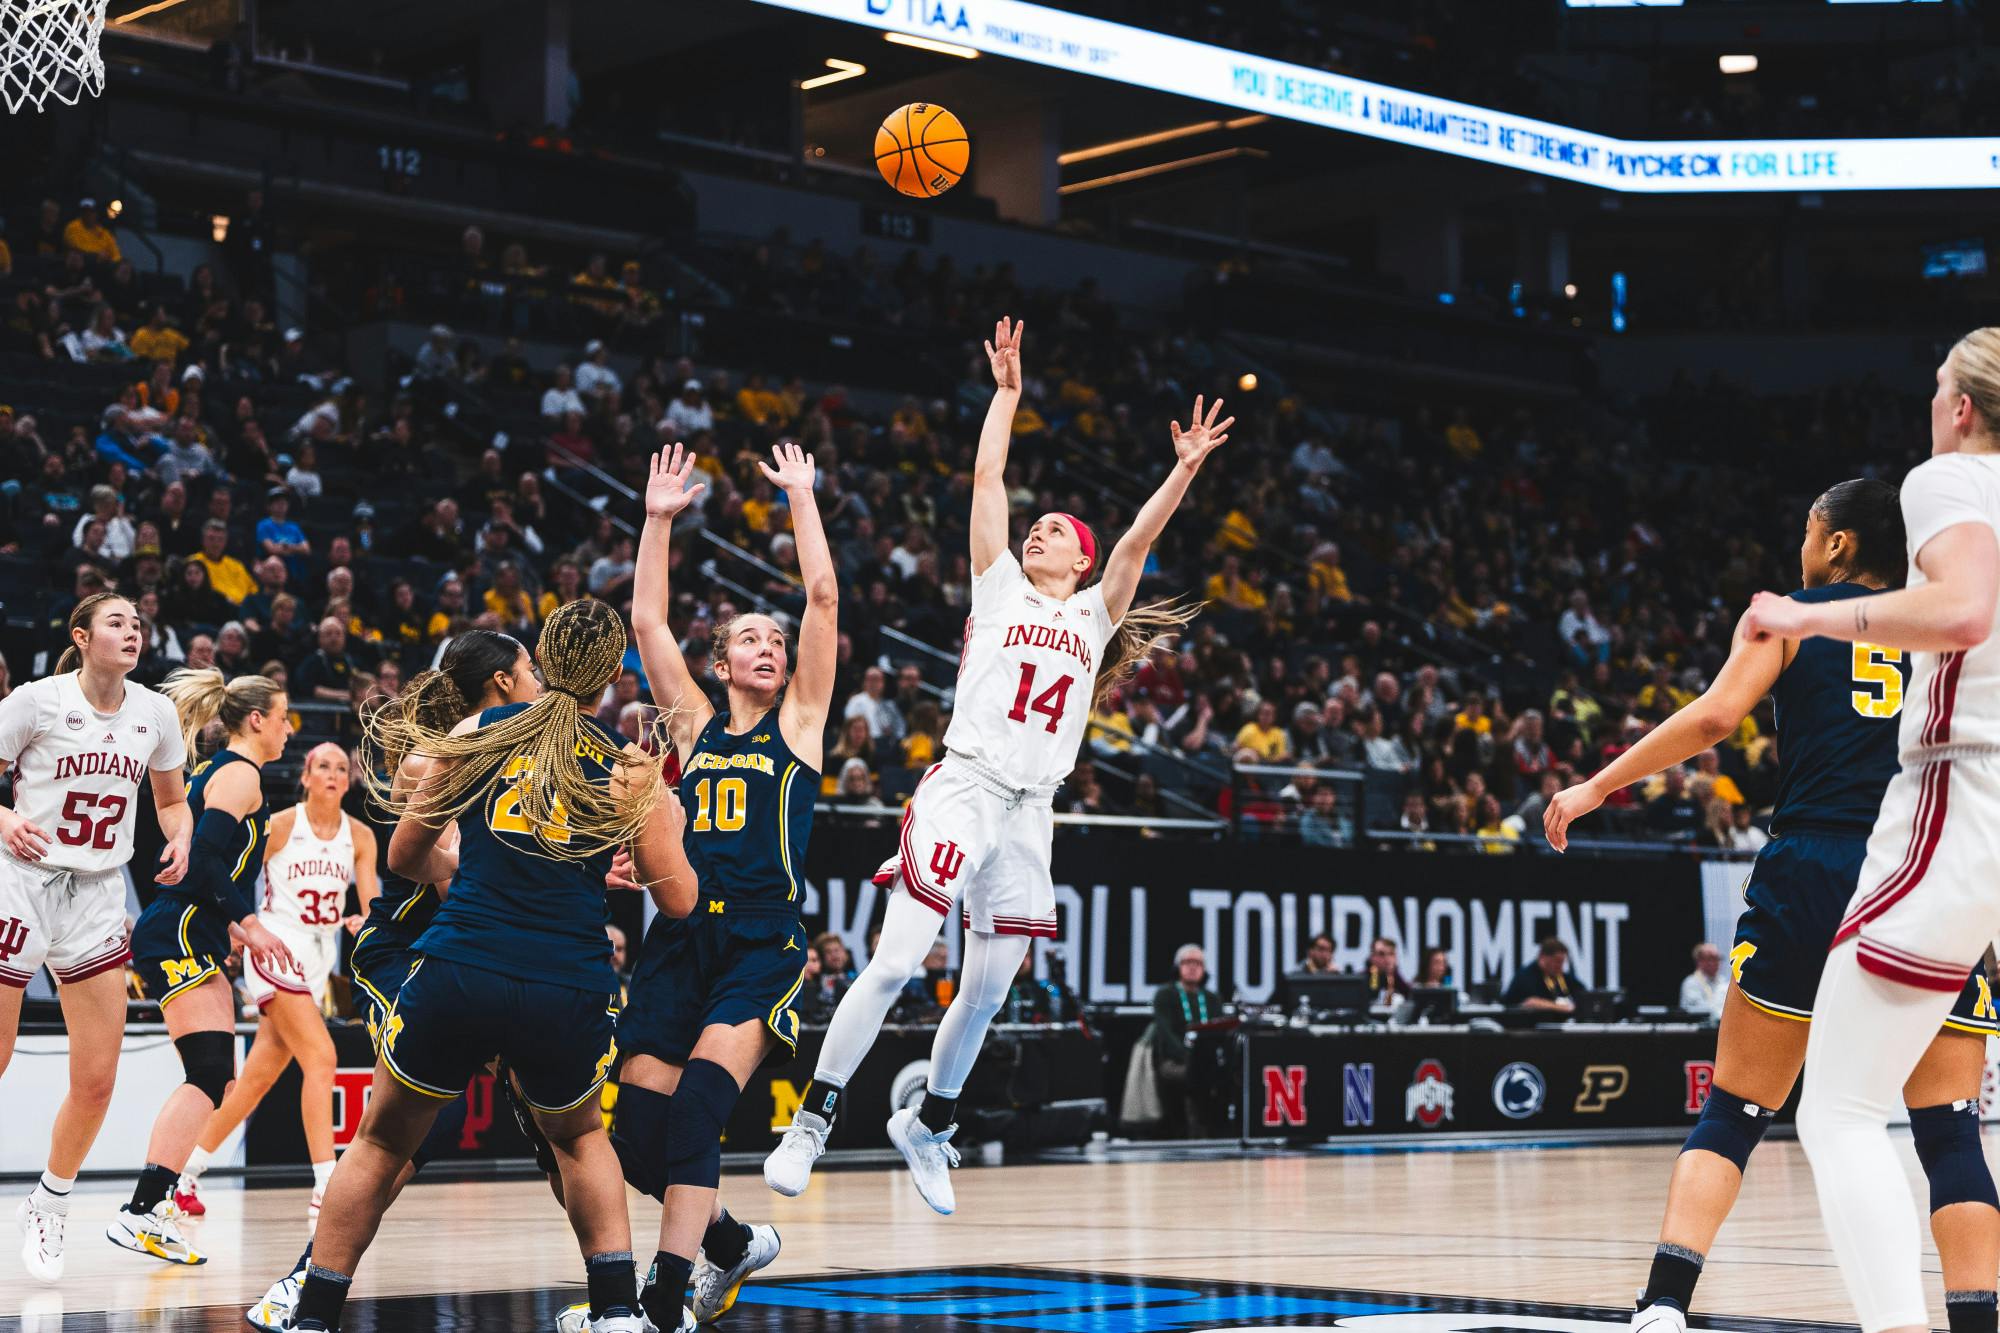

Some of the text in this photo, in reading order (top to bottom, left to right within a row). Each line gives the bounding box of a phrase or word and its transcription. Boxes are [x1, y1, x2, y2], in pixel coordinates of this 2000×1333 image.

[1232, 64, 1267, 97] YOU
[1274, 75, 1353, 117] DESERVE
[1361, 95, 1371, 119] A
[1379, 98, 1490, 146] GUARANTEED
[1498, 125, 1600, 170] RETIREMENT
[1607, 149, 1722, 178] PAYCHECK
[1730, 151, 1777, 178] FOR
[377, 146, 420, 177] 112
[1003, 624, 1092, 674] INDIANA
[1008, 661, 1074, 735] 14
[1852, 640, 1903, 718] 5
[54, 752, 144, 787] INDIANA
[56, 790, 128, 850] 52
[693, 778, 747, 832] 10
[297, 889, 340, 926] 33
[709, 900, 725, 914] M
[160, 957, 202, 988] M
[1263, 1064, 1307, 1127] N
[1343, 1062, 1374, 1127] N
[1573, 1065, 1630, 1112] P
[1685, 1060, 1715, 1114] R
